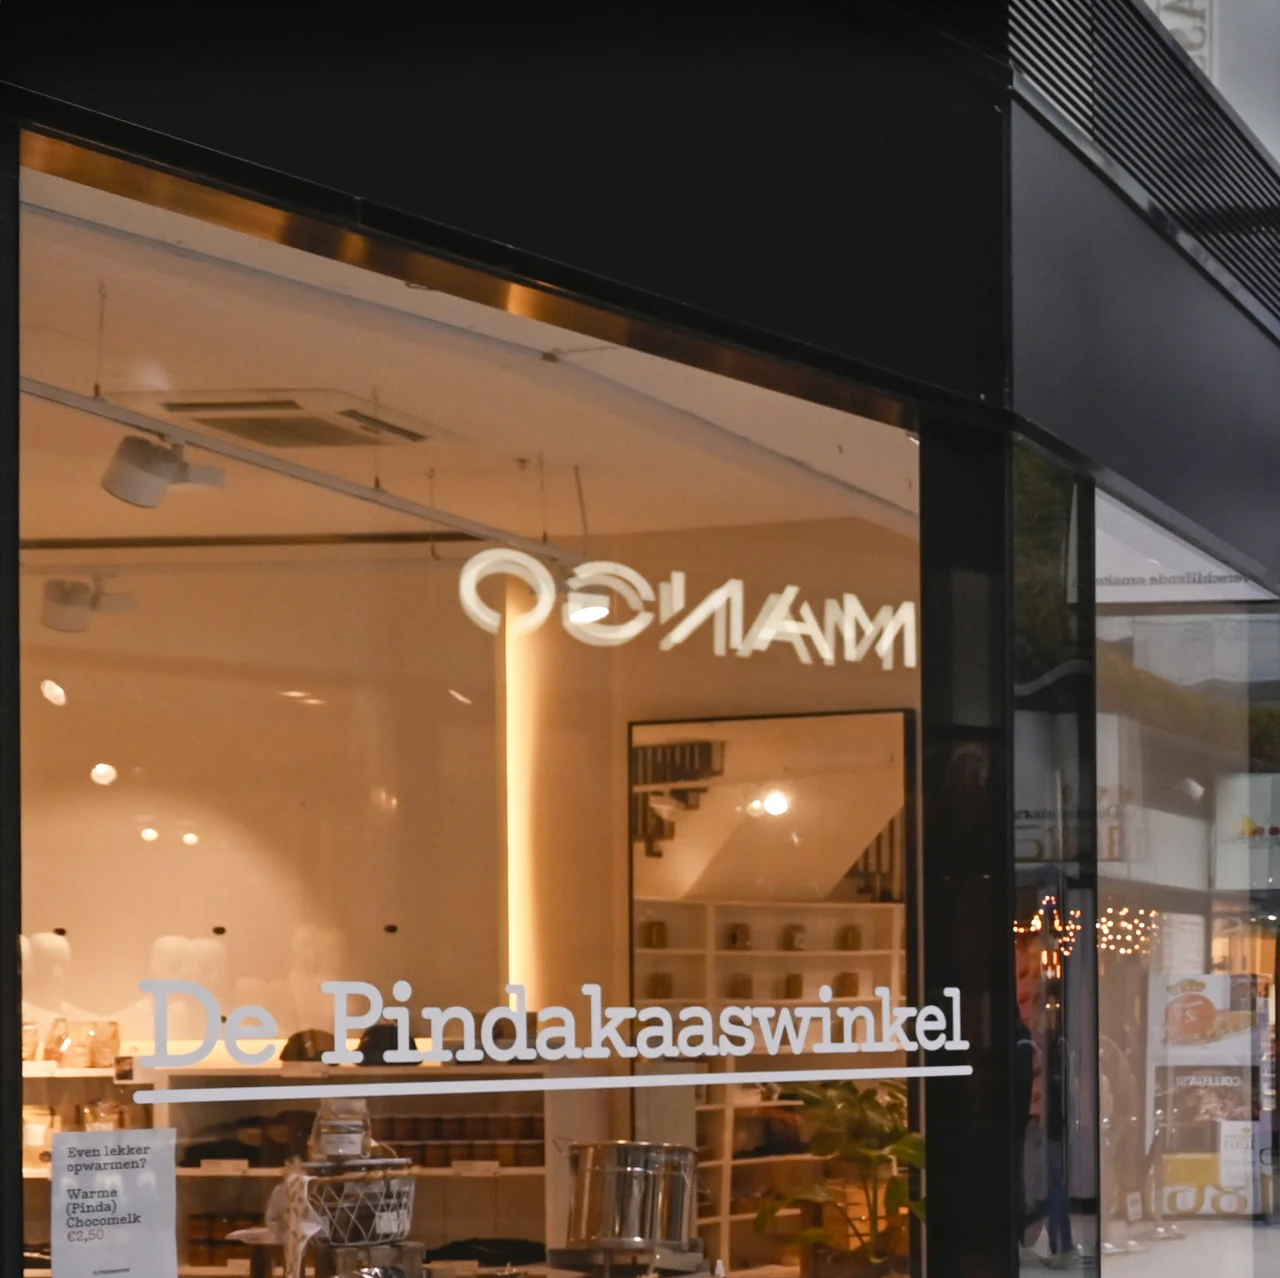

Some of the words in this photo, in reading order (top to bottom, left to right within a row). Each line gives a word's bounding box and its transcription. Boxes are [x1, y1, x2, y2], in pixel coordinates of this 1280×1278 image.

[137, 980, 279, 1068] De
[320, 979, 971, 1066] Pindakaaswinkel
[67, 1147, 101, 1159] Even
[104, 1145, 151, 1157] lekker
[66, 1158, 148, 1175] opwarmen?
[66, 1188, 118, 1200] Warme
[65, 1200, 118, 1217] (Pinda)
[66, 1213, 143, 1229] Chocomelk
[66, 1228, 105, 1245] €2,50
